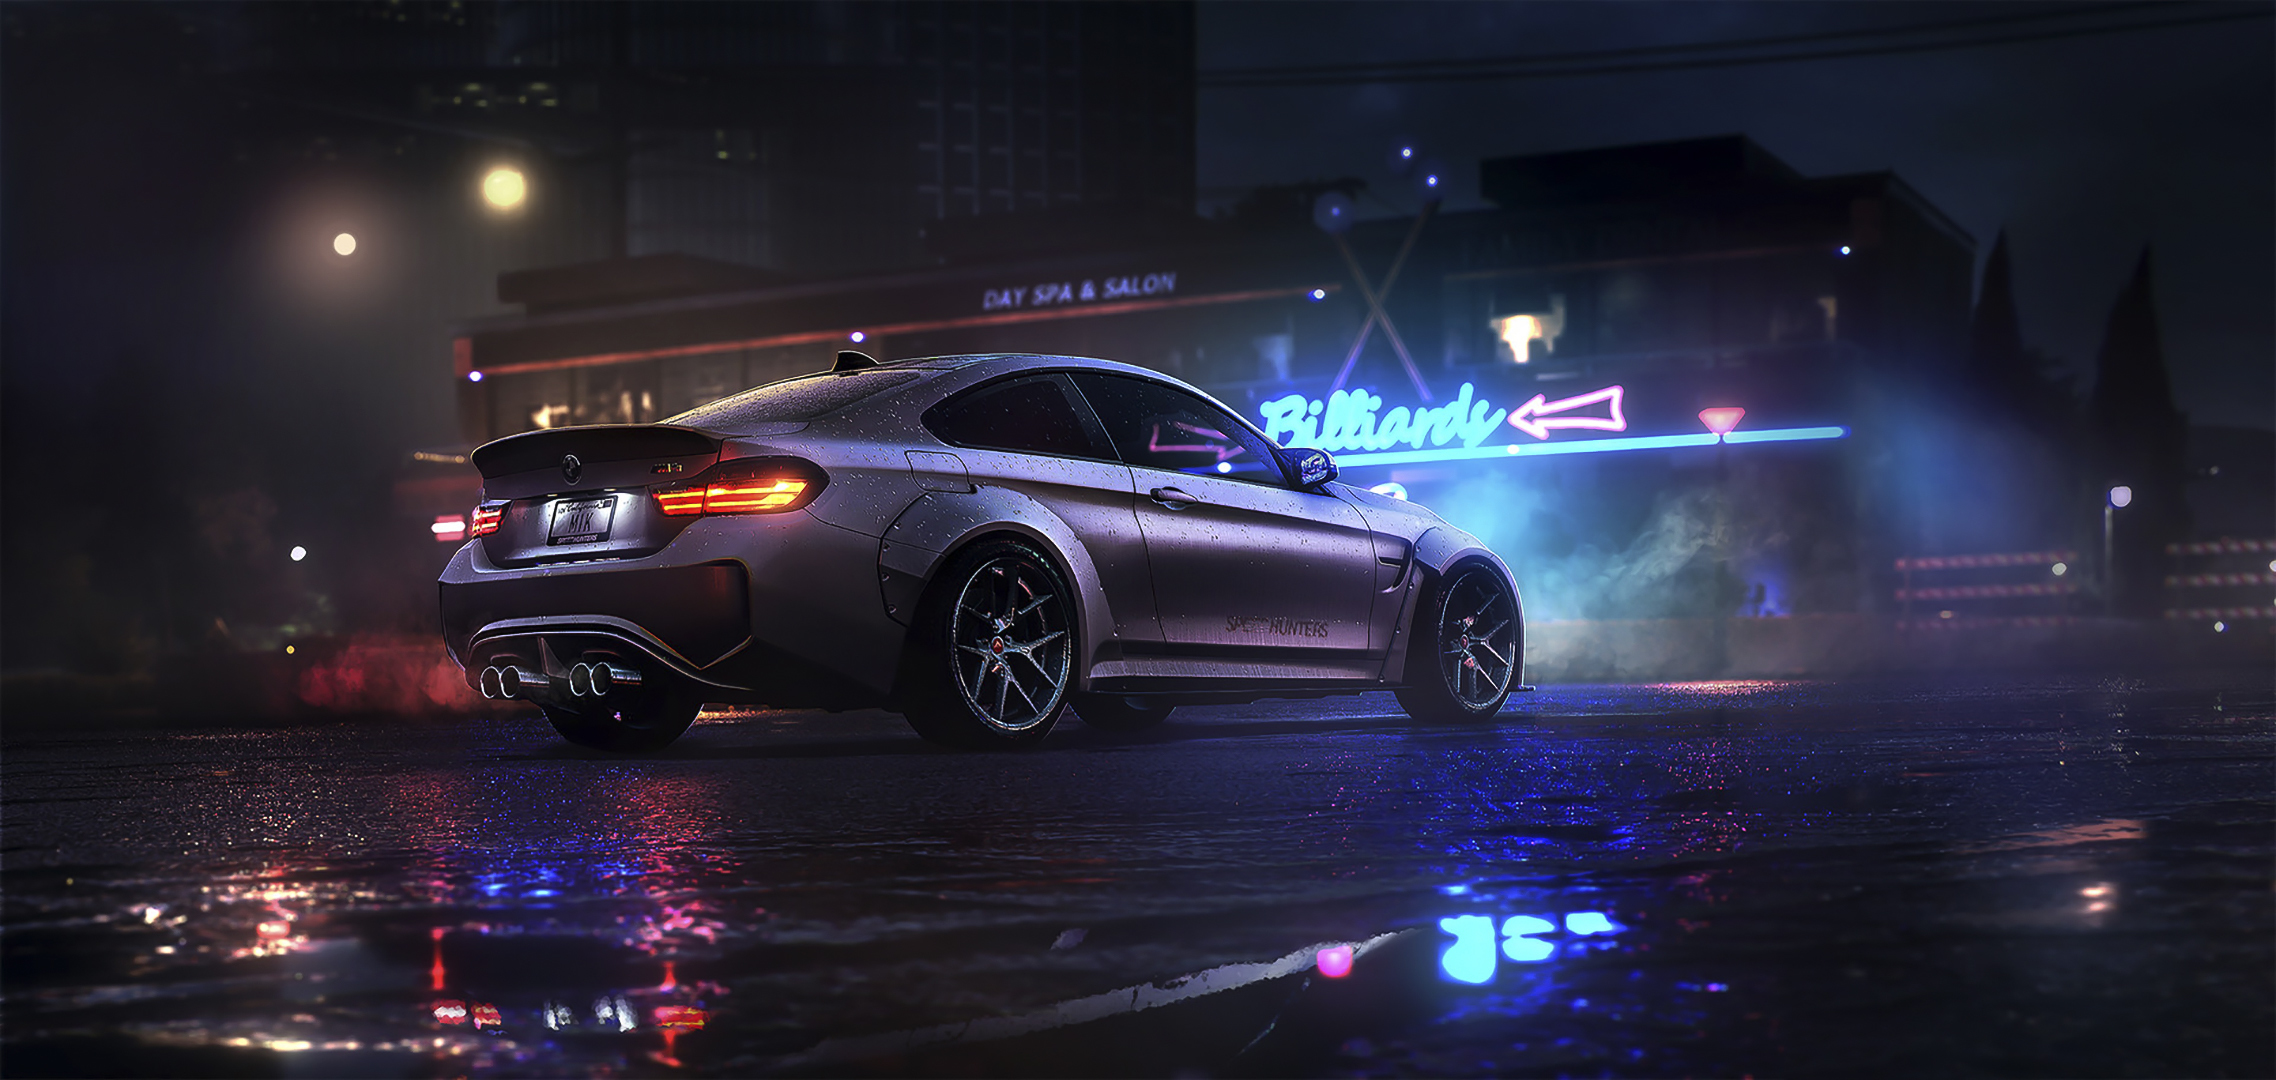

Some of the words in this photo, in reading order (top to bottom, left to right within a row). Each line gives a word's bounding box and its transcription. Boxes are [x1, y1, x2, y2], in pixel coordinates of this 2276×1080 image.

[982, 286, 1028, 311] DAY
[1031, 280, 1074, 306] SPA
[1078, 278, 1097, 302] &
[1102, 271, 1177, 300] SALON
[1259, 381, 1507, 452] Billiards
